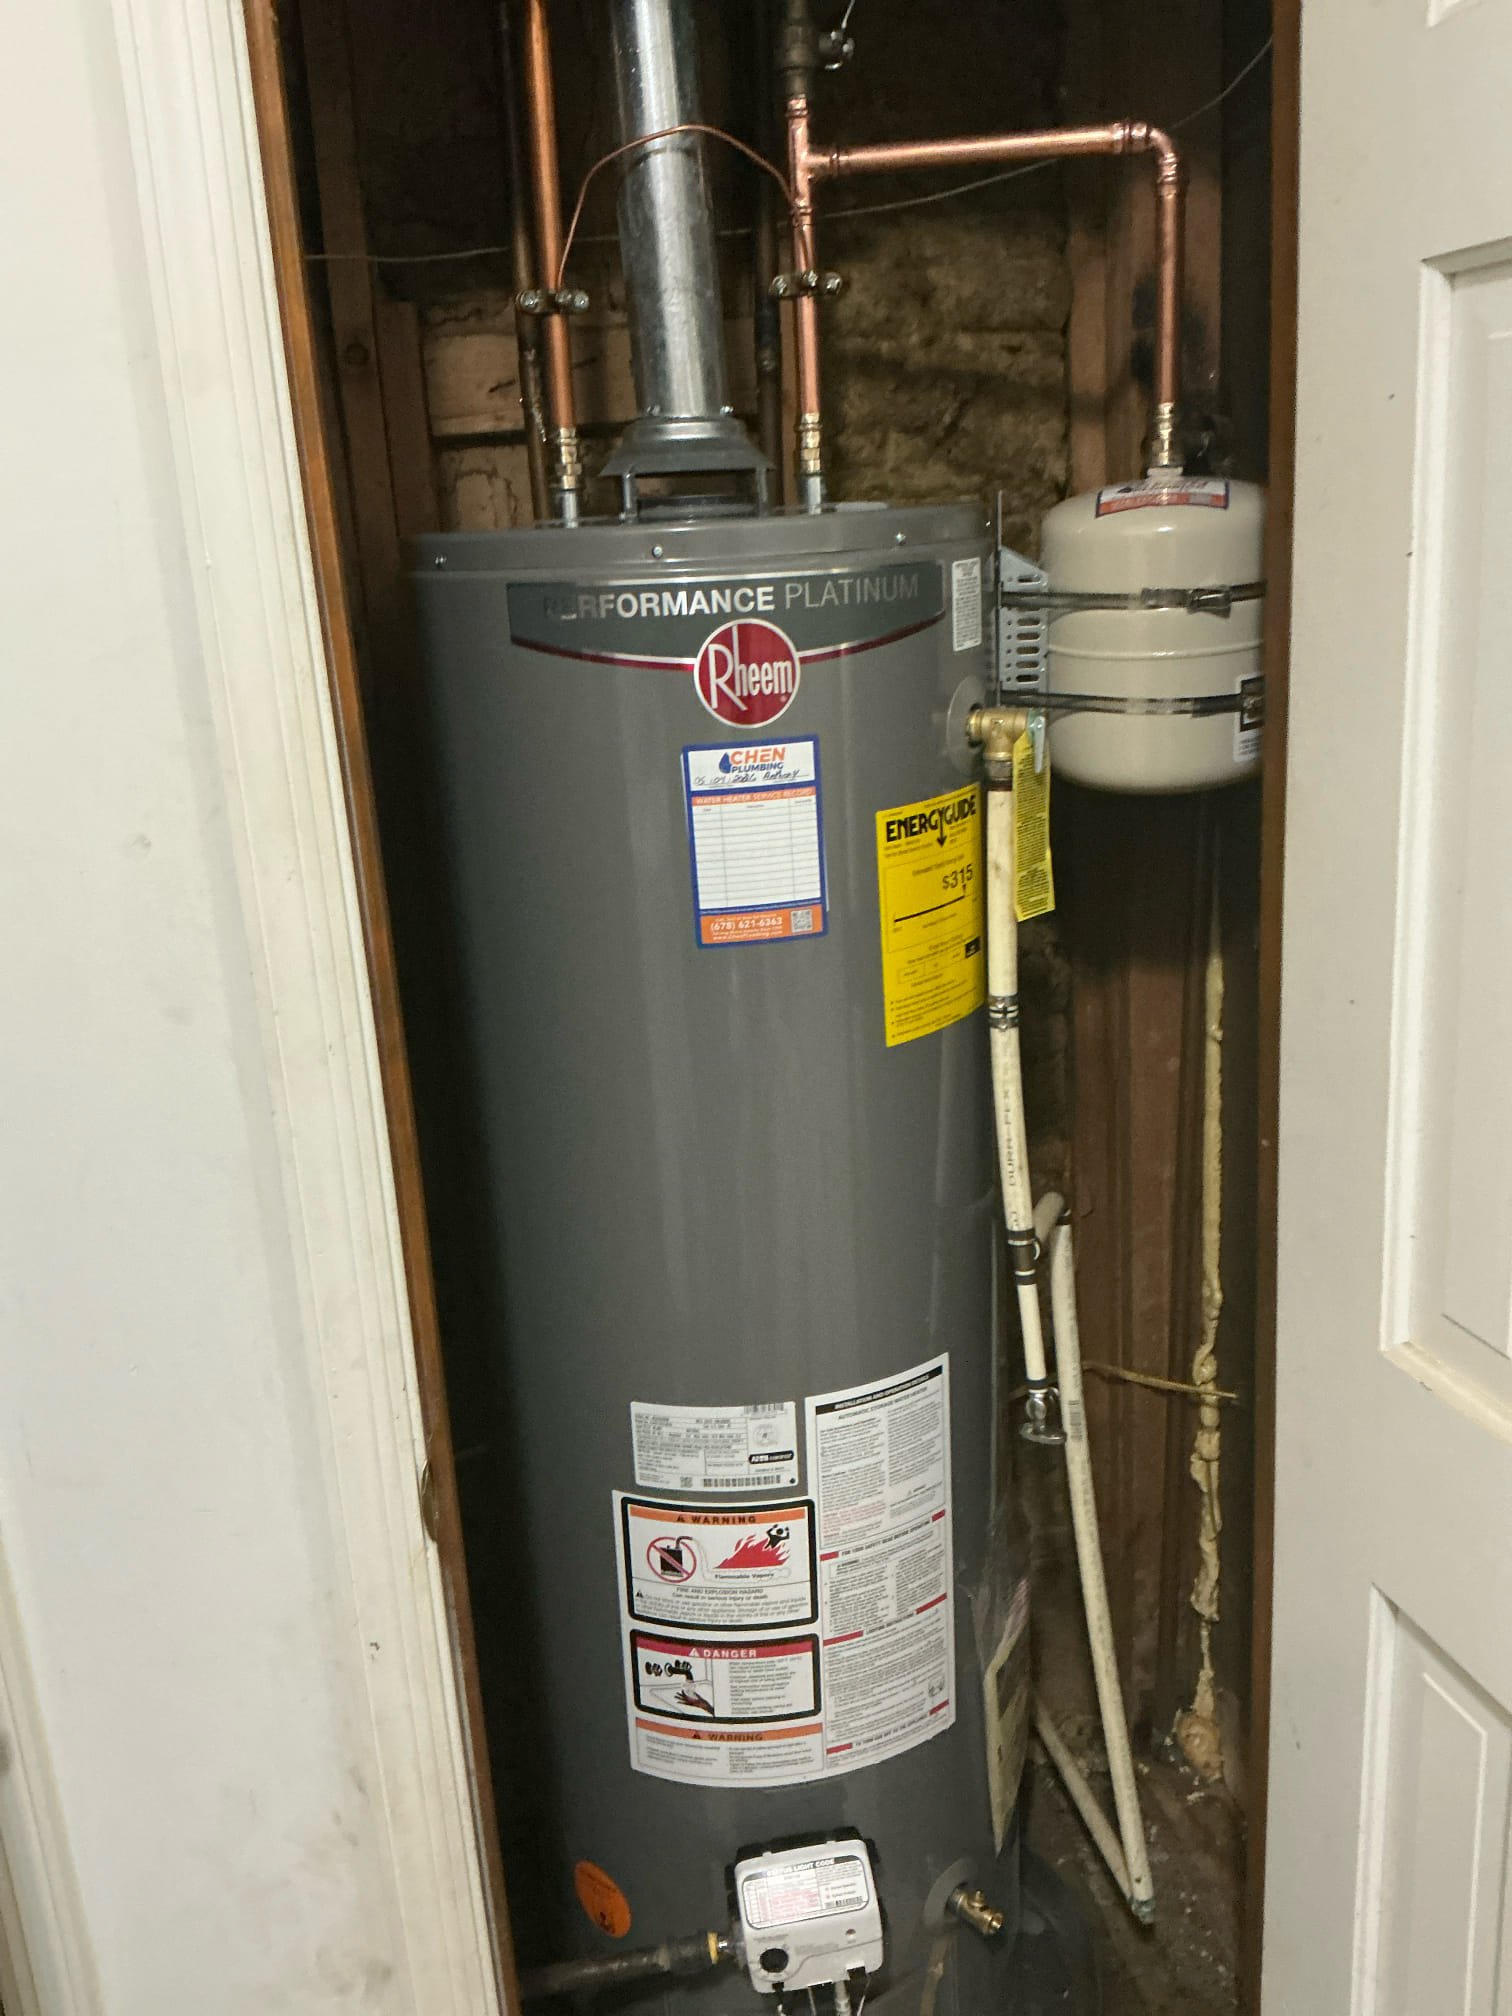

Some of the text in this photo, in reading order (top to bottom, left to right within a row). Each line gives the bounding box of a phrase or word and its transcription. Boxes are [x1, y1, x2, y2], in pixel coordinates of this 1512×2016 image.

[545, 586, 774, 620] RFORMANCE
[784, 573, 919, 609] PLATINUM
[708, 623, 793, 711] Rheem
[730, 747, 786, 765] CHEN
[731, 762, 785, 773] PLUMBING
[886, 795, 977, 844] ENERGYGUIDE
[691, 1515, 757, 1525] WARNING
[703, 1649, 758, 1659] DANGER
[708, 1733, 764, 1742] WARNING
